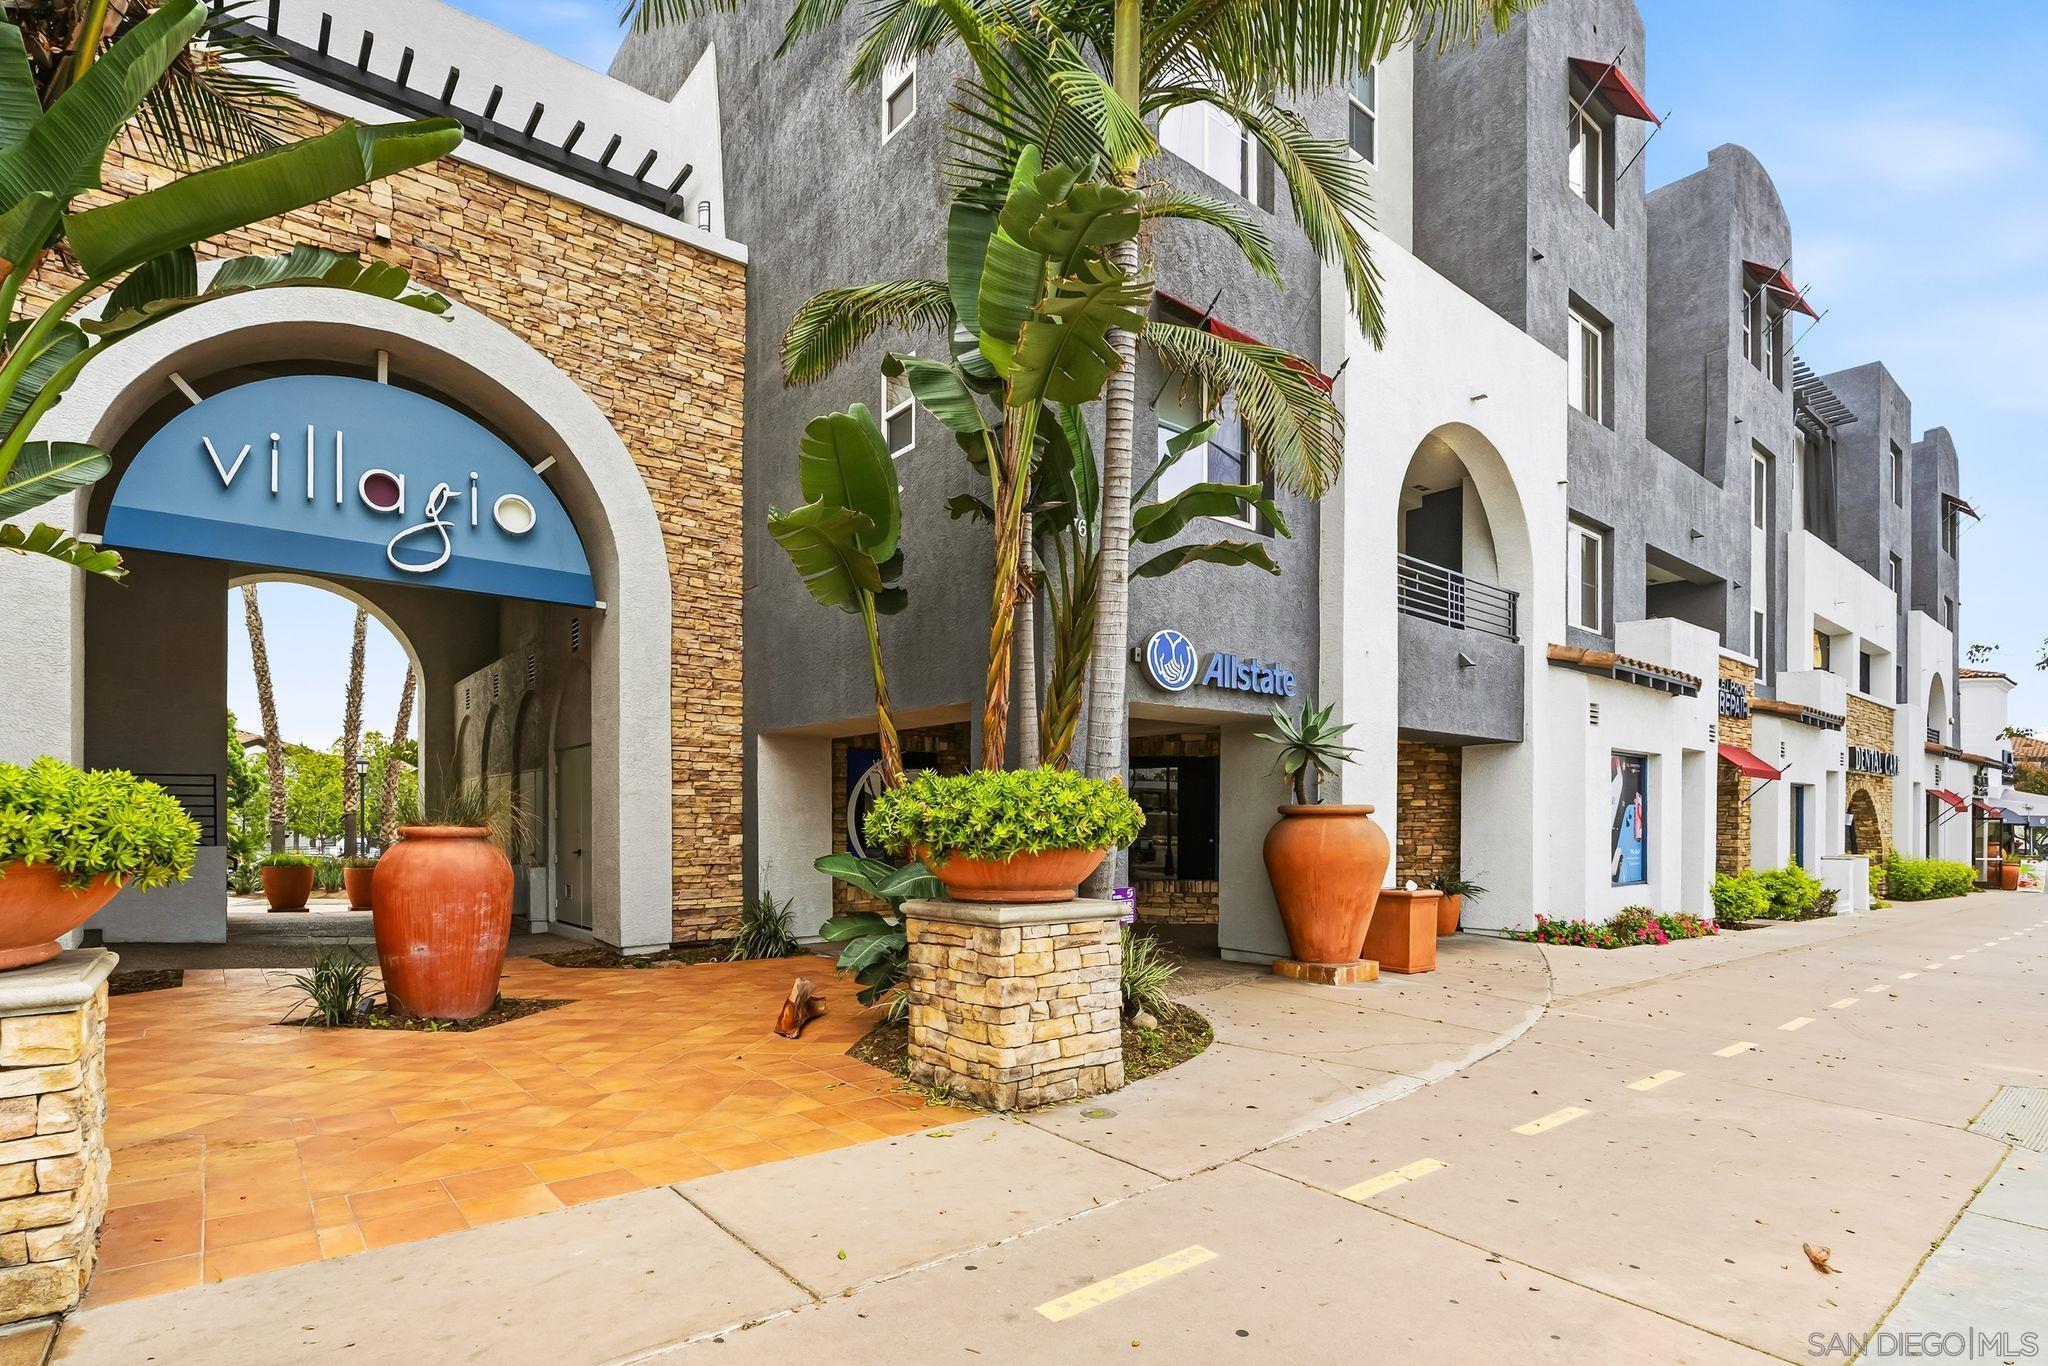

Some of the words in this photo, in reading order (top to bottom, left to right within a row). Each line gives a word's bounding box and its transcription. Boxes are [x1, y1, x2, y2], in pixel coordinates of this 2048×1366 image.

[202, 424, 536, 573] villagio
[1202, 651, 1297, 697] Allstate
[1719, 690, 1748, 719] REPAIR
[1855, 746, 1882, 773] DENTAL
